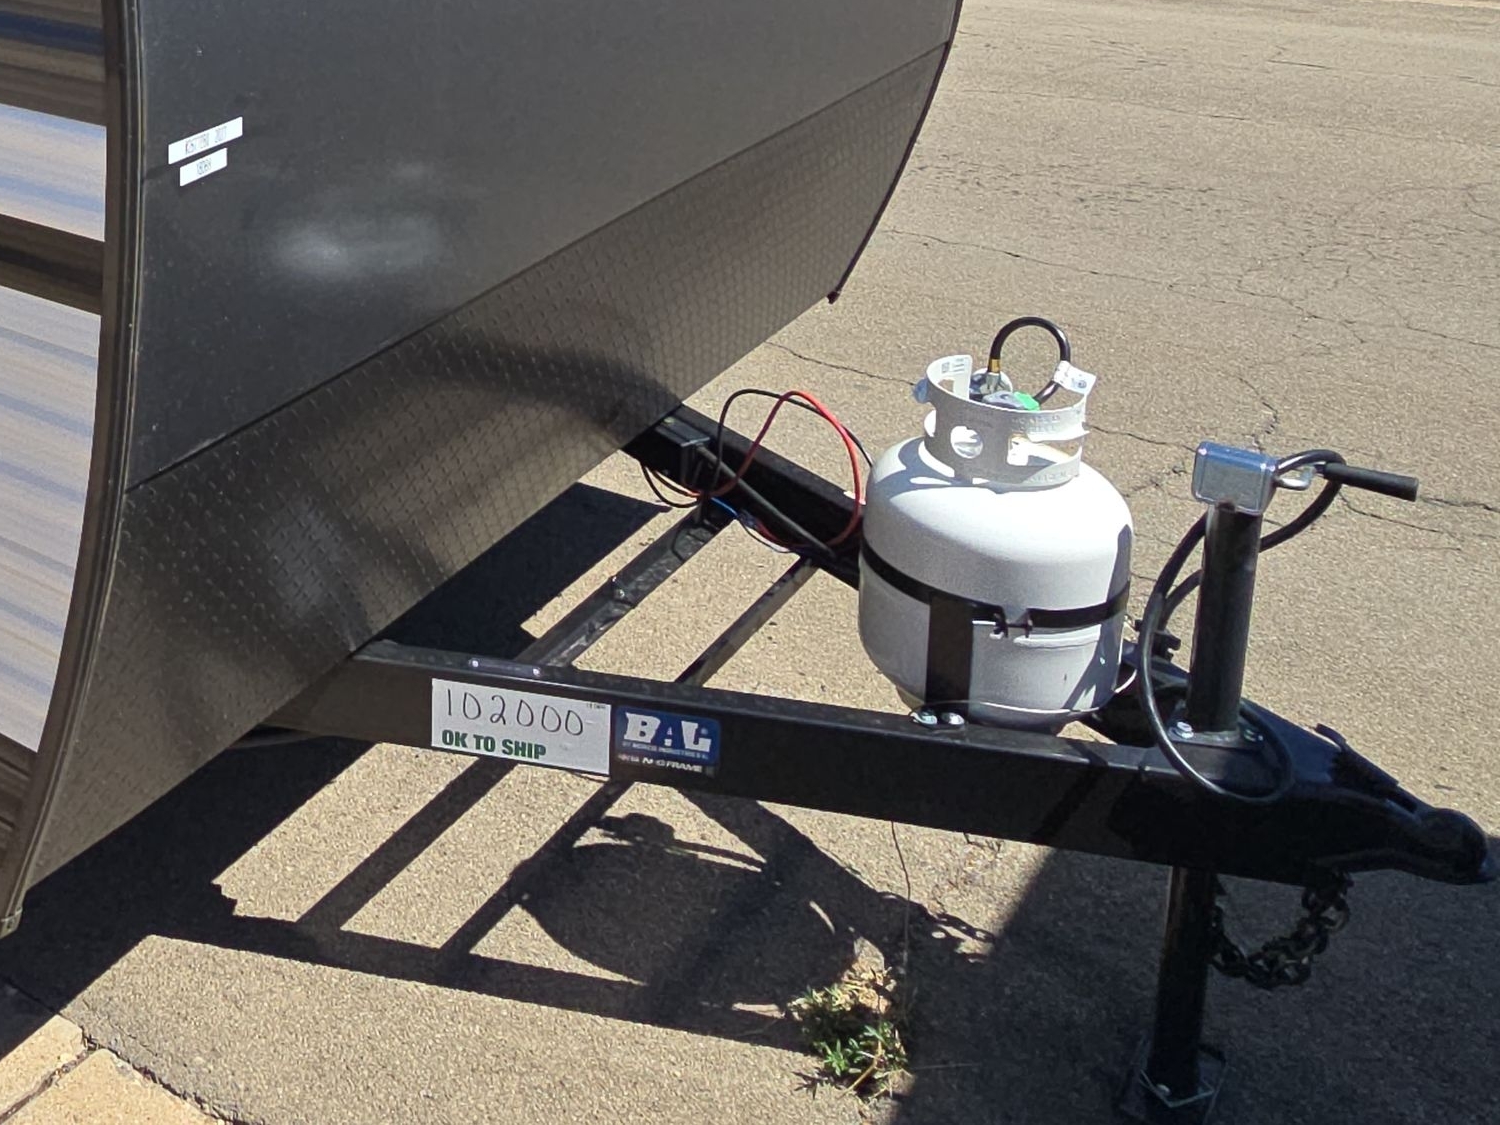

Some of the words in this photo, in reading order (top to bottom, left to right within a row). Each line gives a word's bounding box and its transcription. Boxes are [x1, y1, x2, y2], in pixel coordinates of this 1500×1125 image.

[447, 688, 584, 736] 102000
[623, 711, 712, 753] BAL
[441, 729, 468, 749] OK
[473, 734, 496, 752] TO
[501, 738, 547, 760] SHIP
